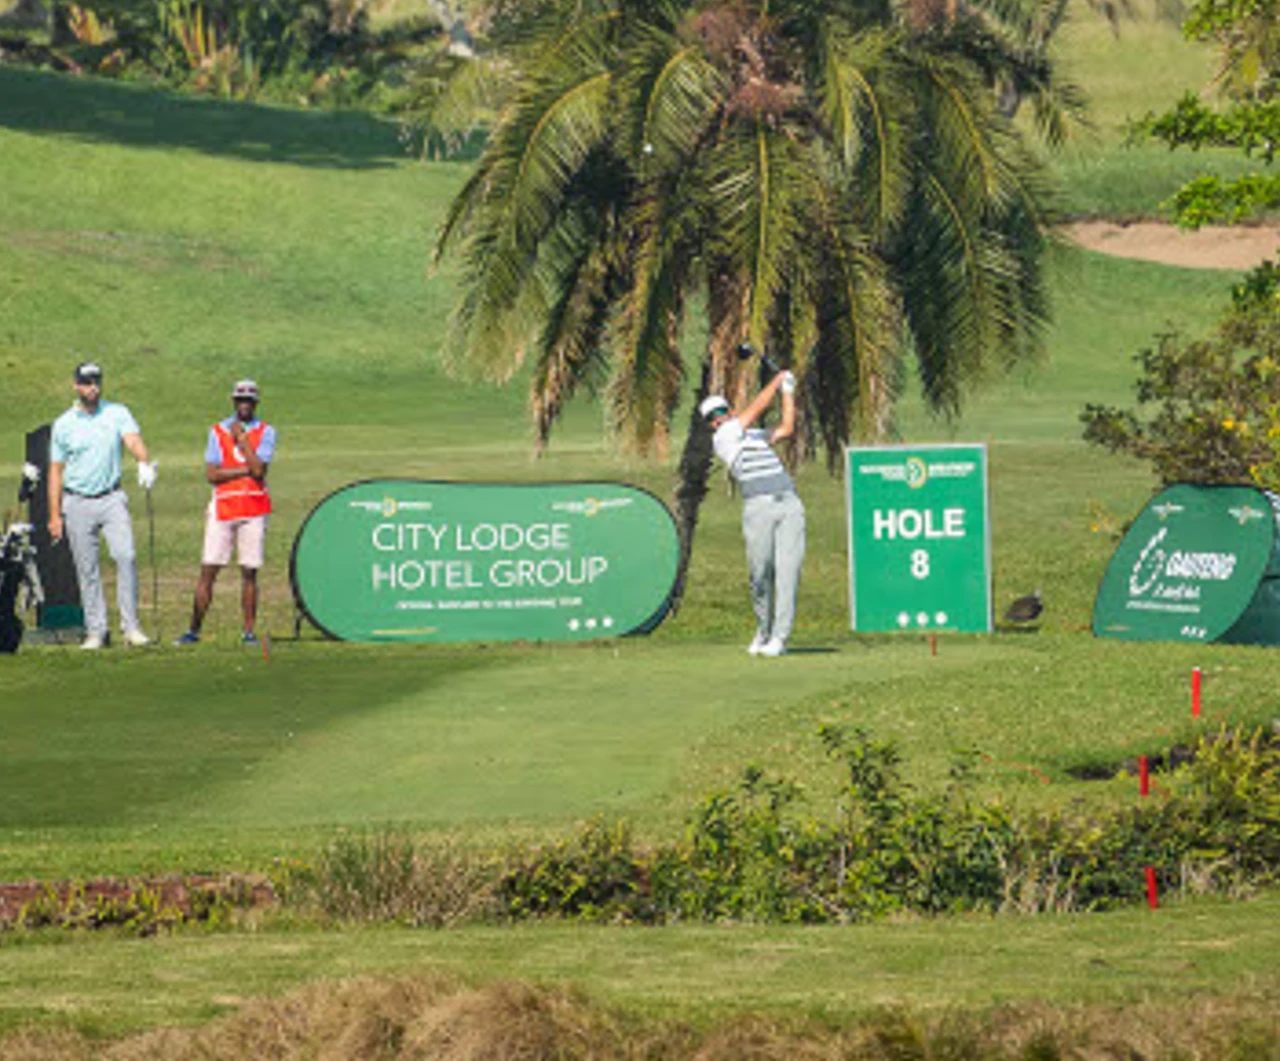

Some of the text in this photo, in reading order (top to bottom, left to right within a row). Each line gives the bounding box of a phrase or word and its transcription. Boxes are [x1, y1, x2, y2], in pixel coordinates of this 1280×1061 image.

[371, 522, 570, 551] CITY LODGE
[872, 508, 966, 540] HOLE
[371, 556, 609, 591] HOTEL GROUP
[910, 548, 930, 580] 8
